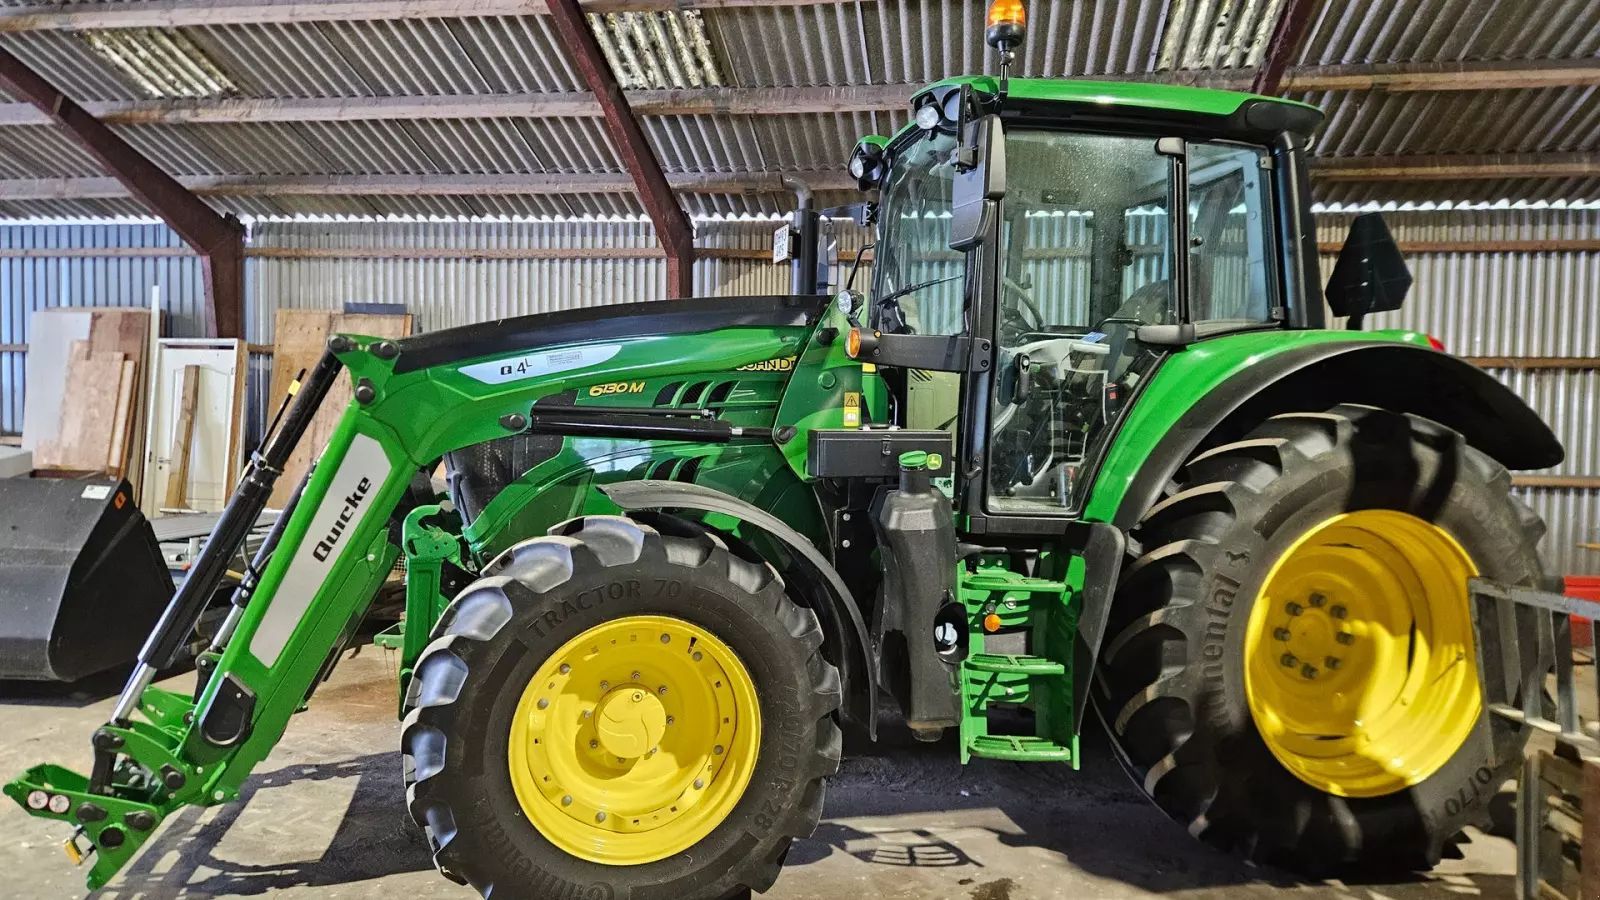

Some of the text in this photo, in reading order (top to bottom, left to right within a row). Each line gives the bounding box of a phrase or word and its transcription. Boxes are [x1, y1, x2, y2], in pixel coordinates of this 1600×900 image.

[736, 359, 778, 371] OHN
[589, 382, 646, 396] 6130 M
[312, 476, 372, 563] Quicke
[526, 578, 683, 640] TRACTOR 70
[753, 799, 782, 830] 28
